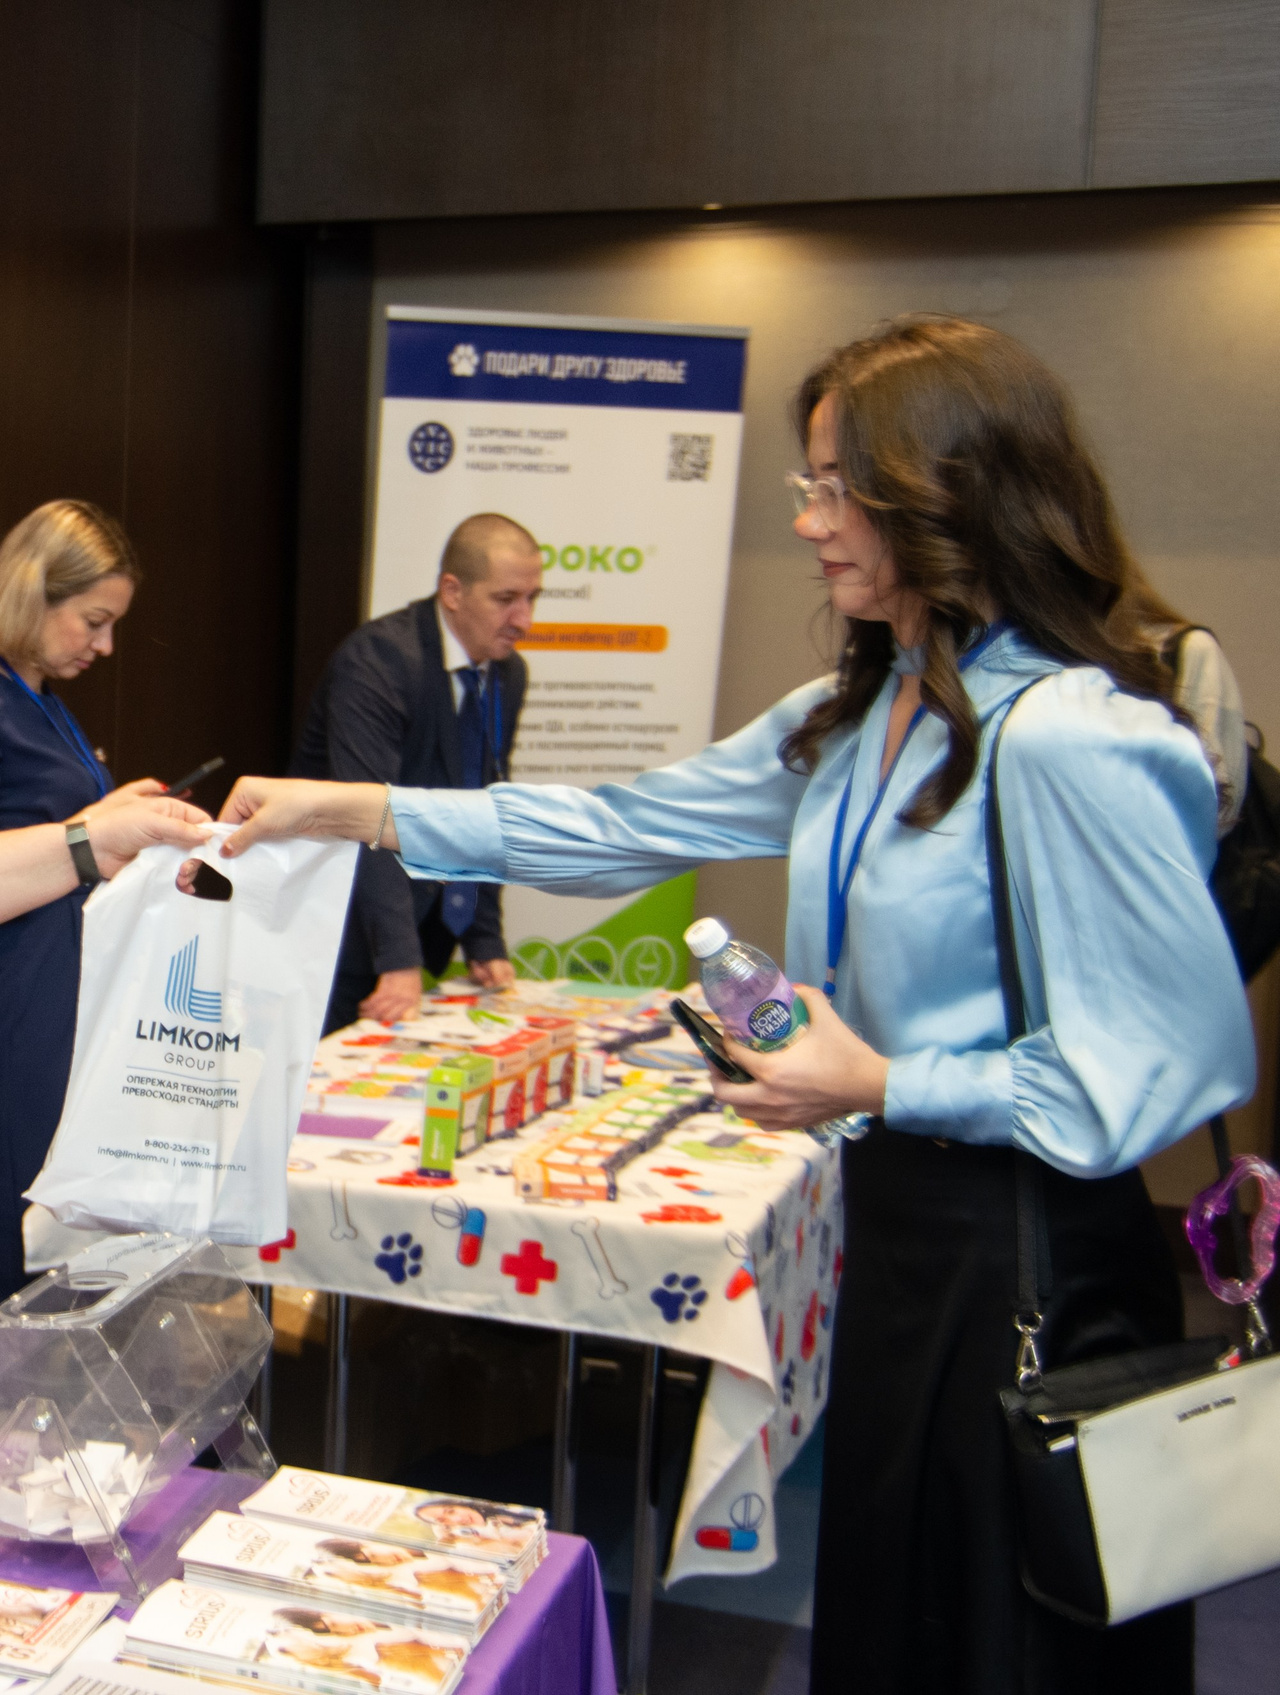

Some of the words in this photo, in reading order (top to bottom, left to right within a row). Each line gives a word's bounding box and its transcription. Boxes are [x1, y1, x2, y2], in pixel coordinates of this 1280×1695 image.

[485, 350, 550, 379] ПОДАРИ
[550, 354, 603, 380] ДРУГУ
[604, 356, 688, 384] ЗДОРОВЬЕ
[750, 1004, 786, 1031] НОРМА
[759, 1011, 791, 1038] ЖИЗНИ
[163, 1052, 216, 1072] GROUP
[125, 1075, 179, 1092] ОПЕРЕЖАЯ
[121, 1085, 187, 1104] ПРЕВОСХОДЯ
[97, 1146, 170, 1165] info@limkorm.ru
